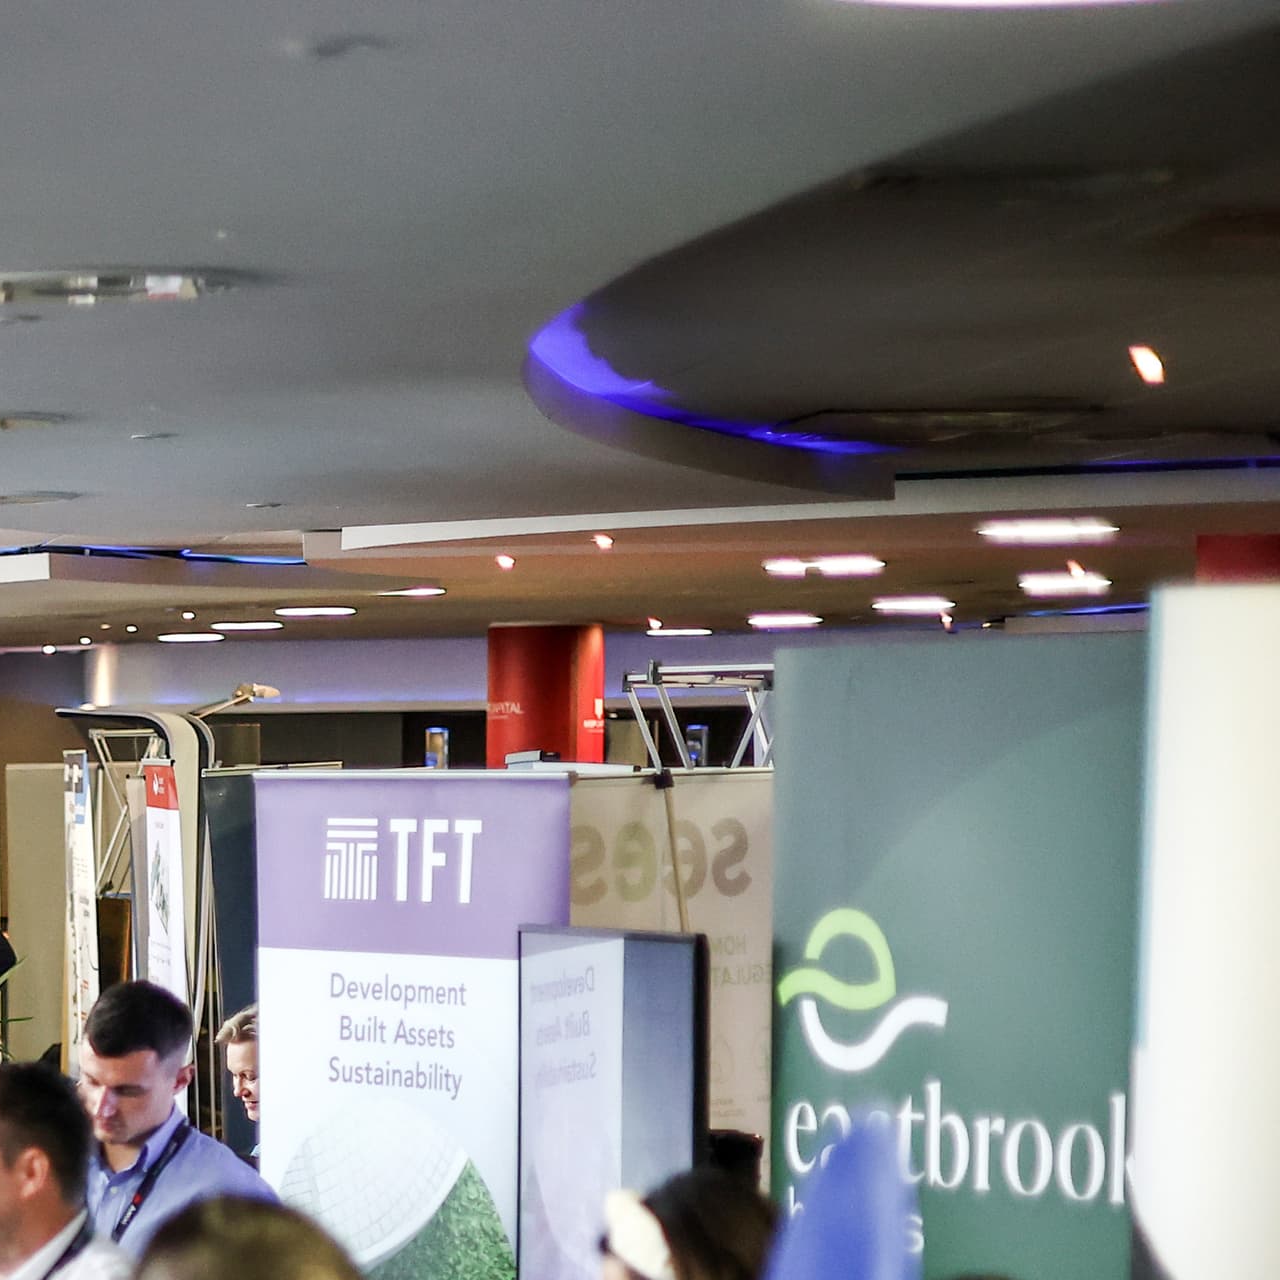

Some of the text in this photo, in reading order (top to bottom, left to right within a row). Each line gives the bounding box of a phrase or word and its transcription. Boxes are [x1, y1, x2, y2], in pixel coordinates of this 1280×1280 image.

[389, 818, 482, 904] TFT
[330, 972, 467, 1010] Development
[339, 1015, 456, 1049] Built Assets
[328, 1055, 463, 1101] Sustainability
